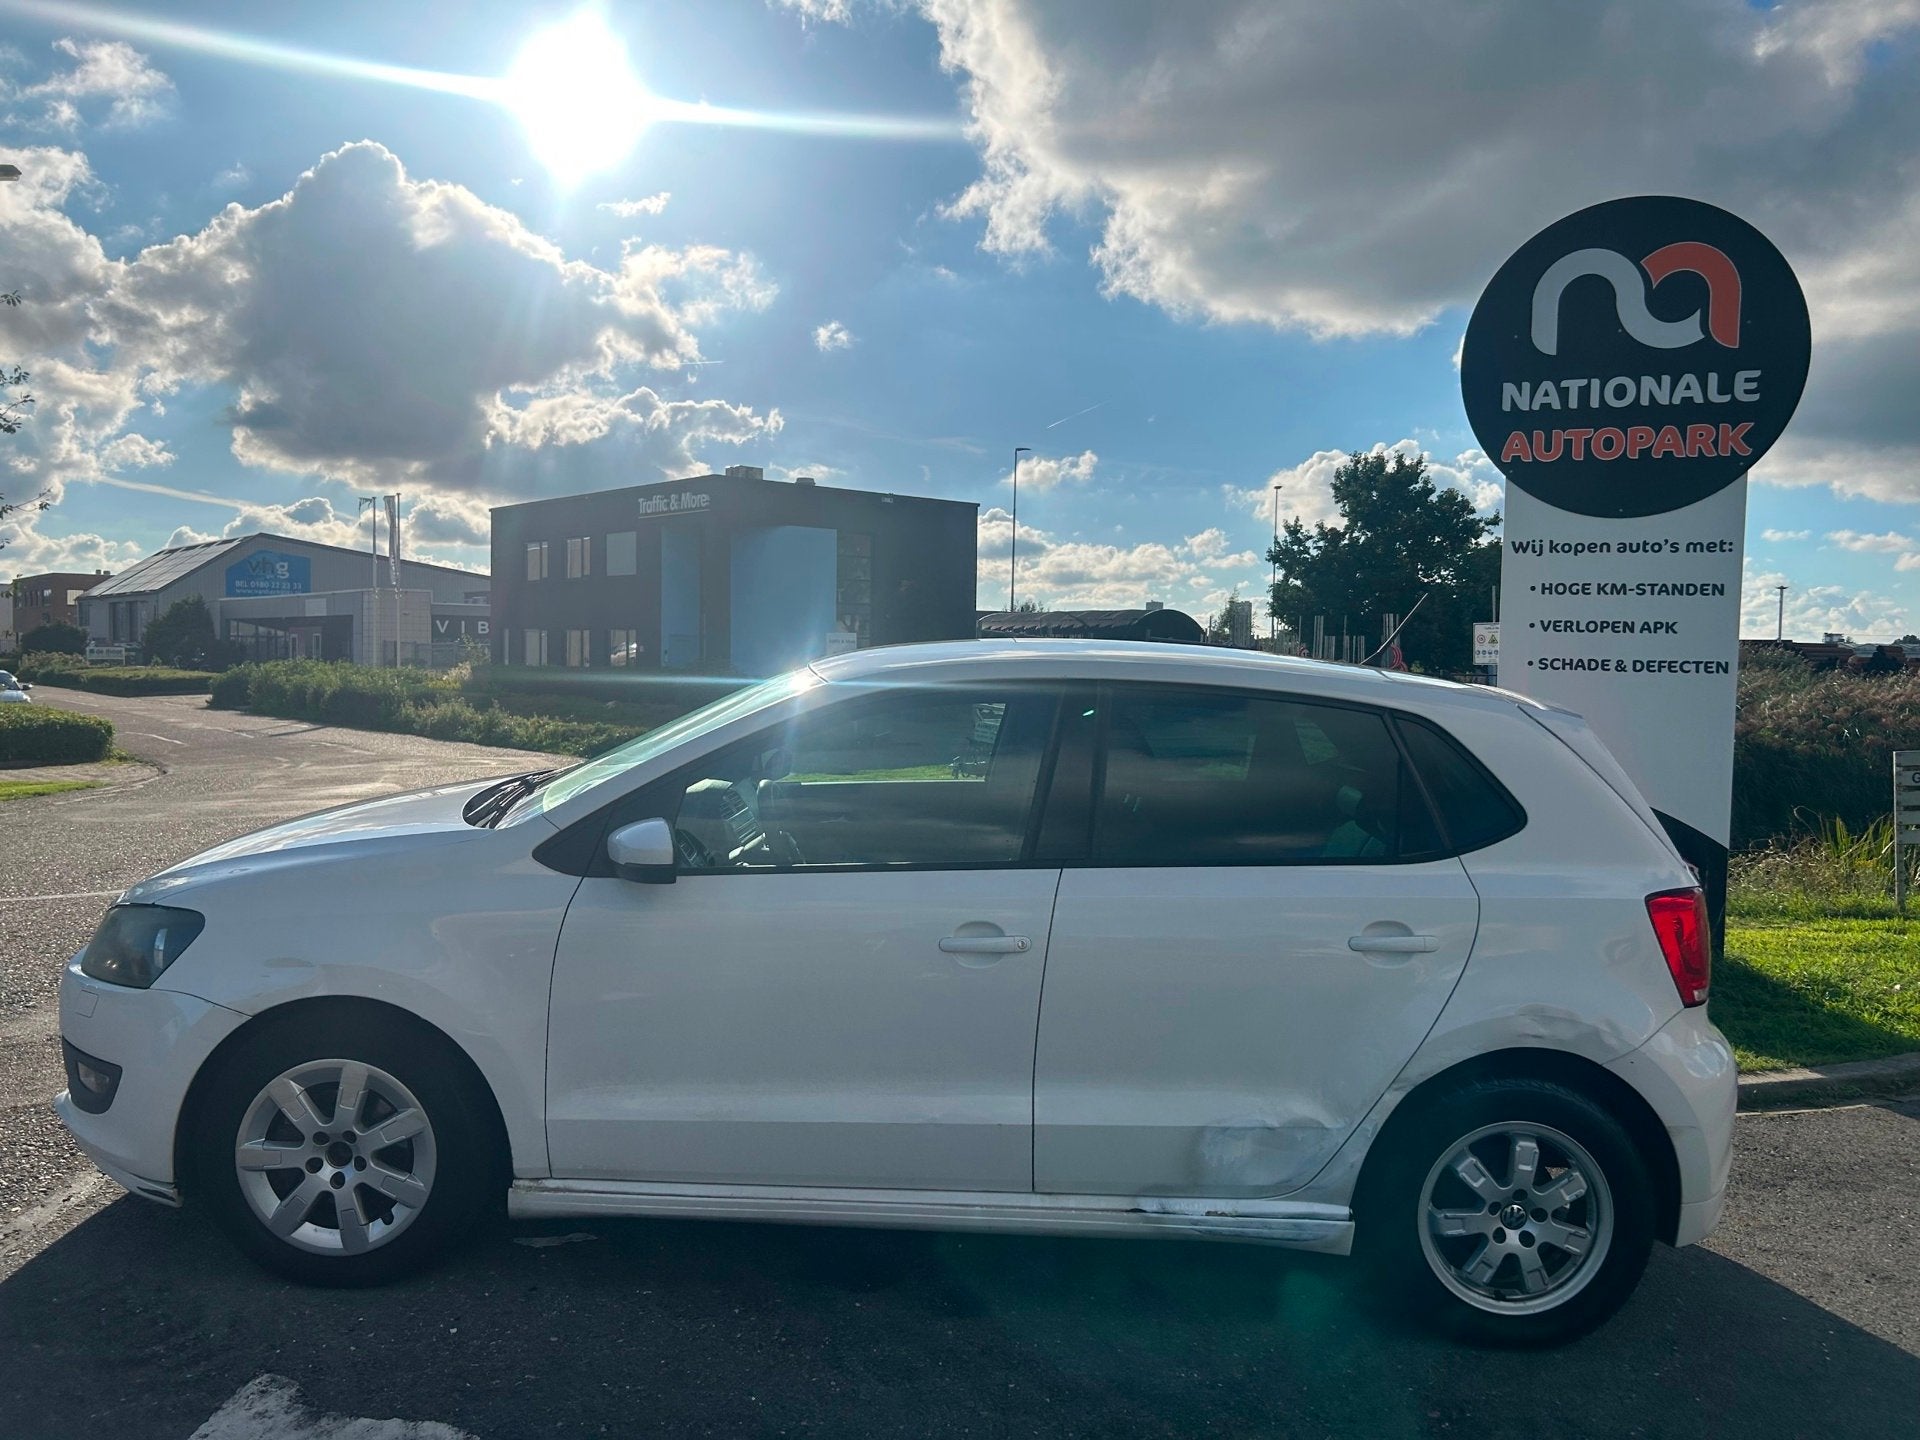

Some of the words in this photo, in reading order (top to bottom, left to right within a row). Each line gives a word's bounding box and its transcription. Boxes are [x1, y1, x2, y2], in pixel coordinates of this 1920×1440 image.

[1501, 369, 1762, 412] NATIONALE
[1500, 422, 1755, 463] AUTOPARK
[638, 495, 667, 513] Traffic
[670, 494, 678, 511] &
[681, 492, 710, 509] More
[1510, 539, 1544, 557] Wij
[1548, 539, 1611, 557] kopen
[1616, 538, 1680, 554] auto's
[1685, 539, 1734, 553] met:
[247, 557, 289, 579] vhg
[1540, 582, 1592, 596] HOGE
[1596, 582, 1725, 597] KM-STANDEN
[1539, 619, 1635, 634] VERLOPEN
[1639, 621, 1678, 635] APK
[1538, 657, 1612, 672] SCHADE
[1614, 659, 1628, 673] &
[1632, 659, 1729, 675] DEFECTEN
